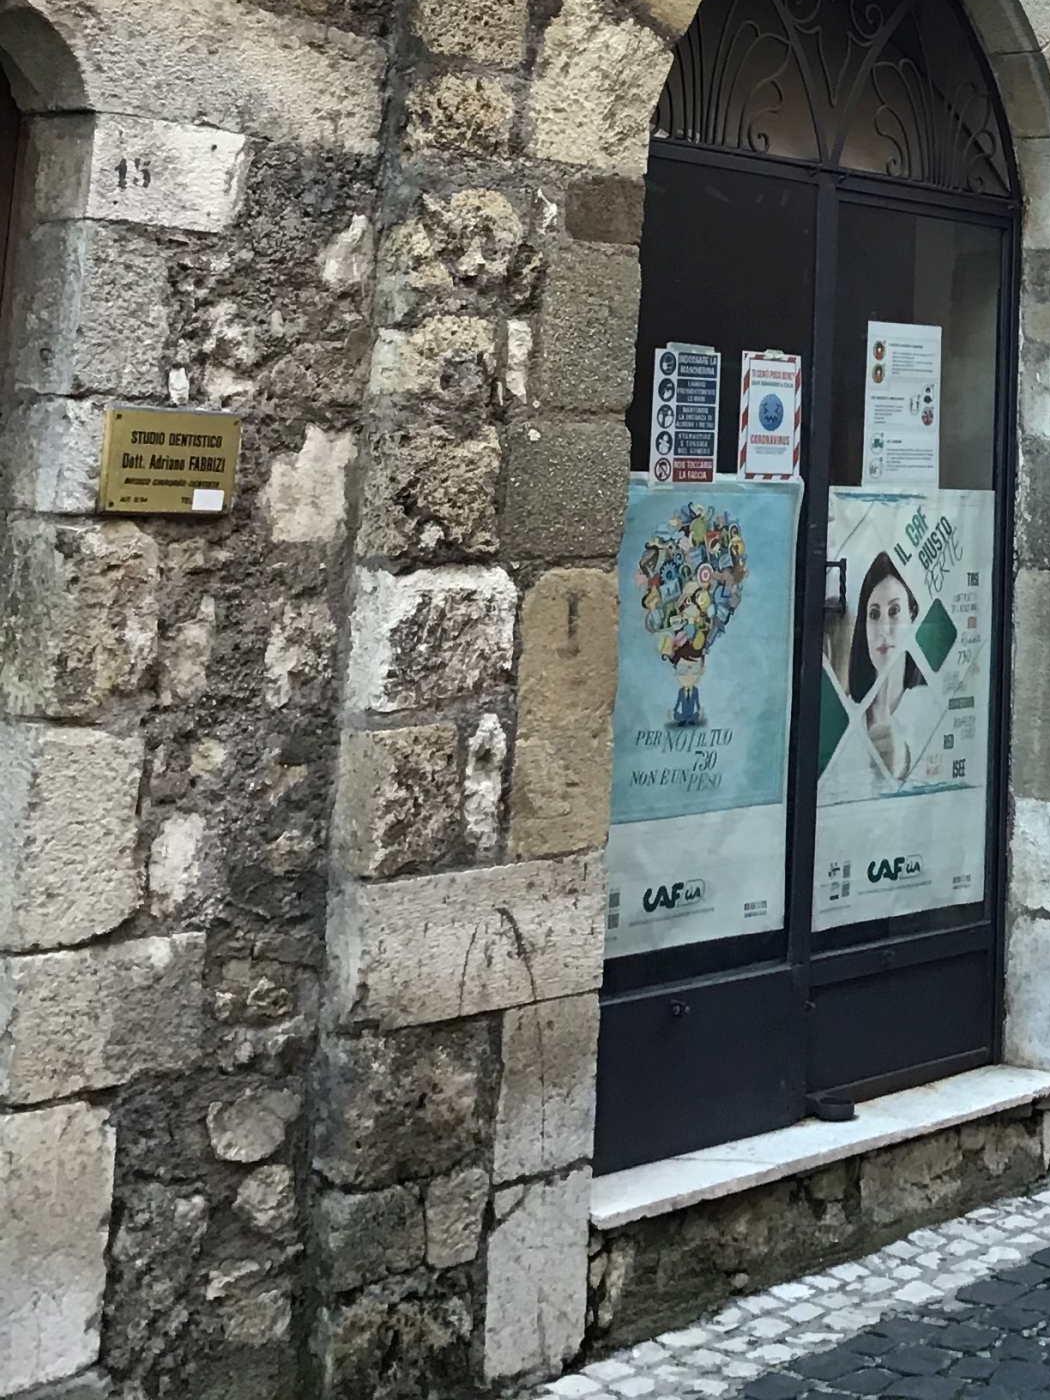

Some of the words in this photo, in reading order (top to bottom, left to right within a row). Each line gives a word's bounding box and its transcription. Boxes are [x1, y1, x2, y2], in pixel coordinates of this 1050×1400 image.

[115, 158, 151, 189] 15
[131, 430, 165, 445] STUDIO
[169, 433, 222, 448] DENTISTICO
[750, 434, 790, 446] CORONAVIRUS
[122, 453, 145, 468] Dott.
[149, 454, 185, 471] Adriano
[189, 456, 226, 473] FABRIZI
[893, 543, 912, 566] IL
[905, 505, 929, 548] CAF
[918, 516, 953, 570] GIUSTO
[635, 730, 663, 746] PER
[661, 728, 697, 753] NOI
[696, 732, 708, 748] IL
[709, 728, 733, 747] TUO
[692, 749, 718, 772] 730
[628, 769, 658, 787] NON
[686, 772, 722, 792] PESO
[867, 856, 905, 884] CAF
[643, 882, 685, 913] CAF
